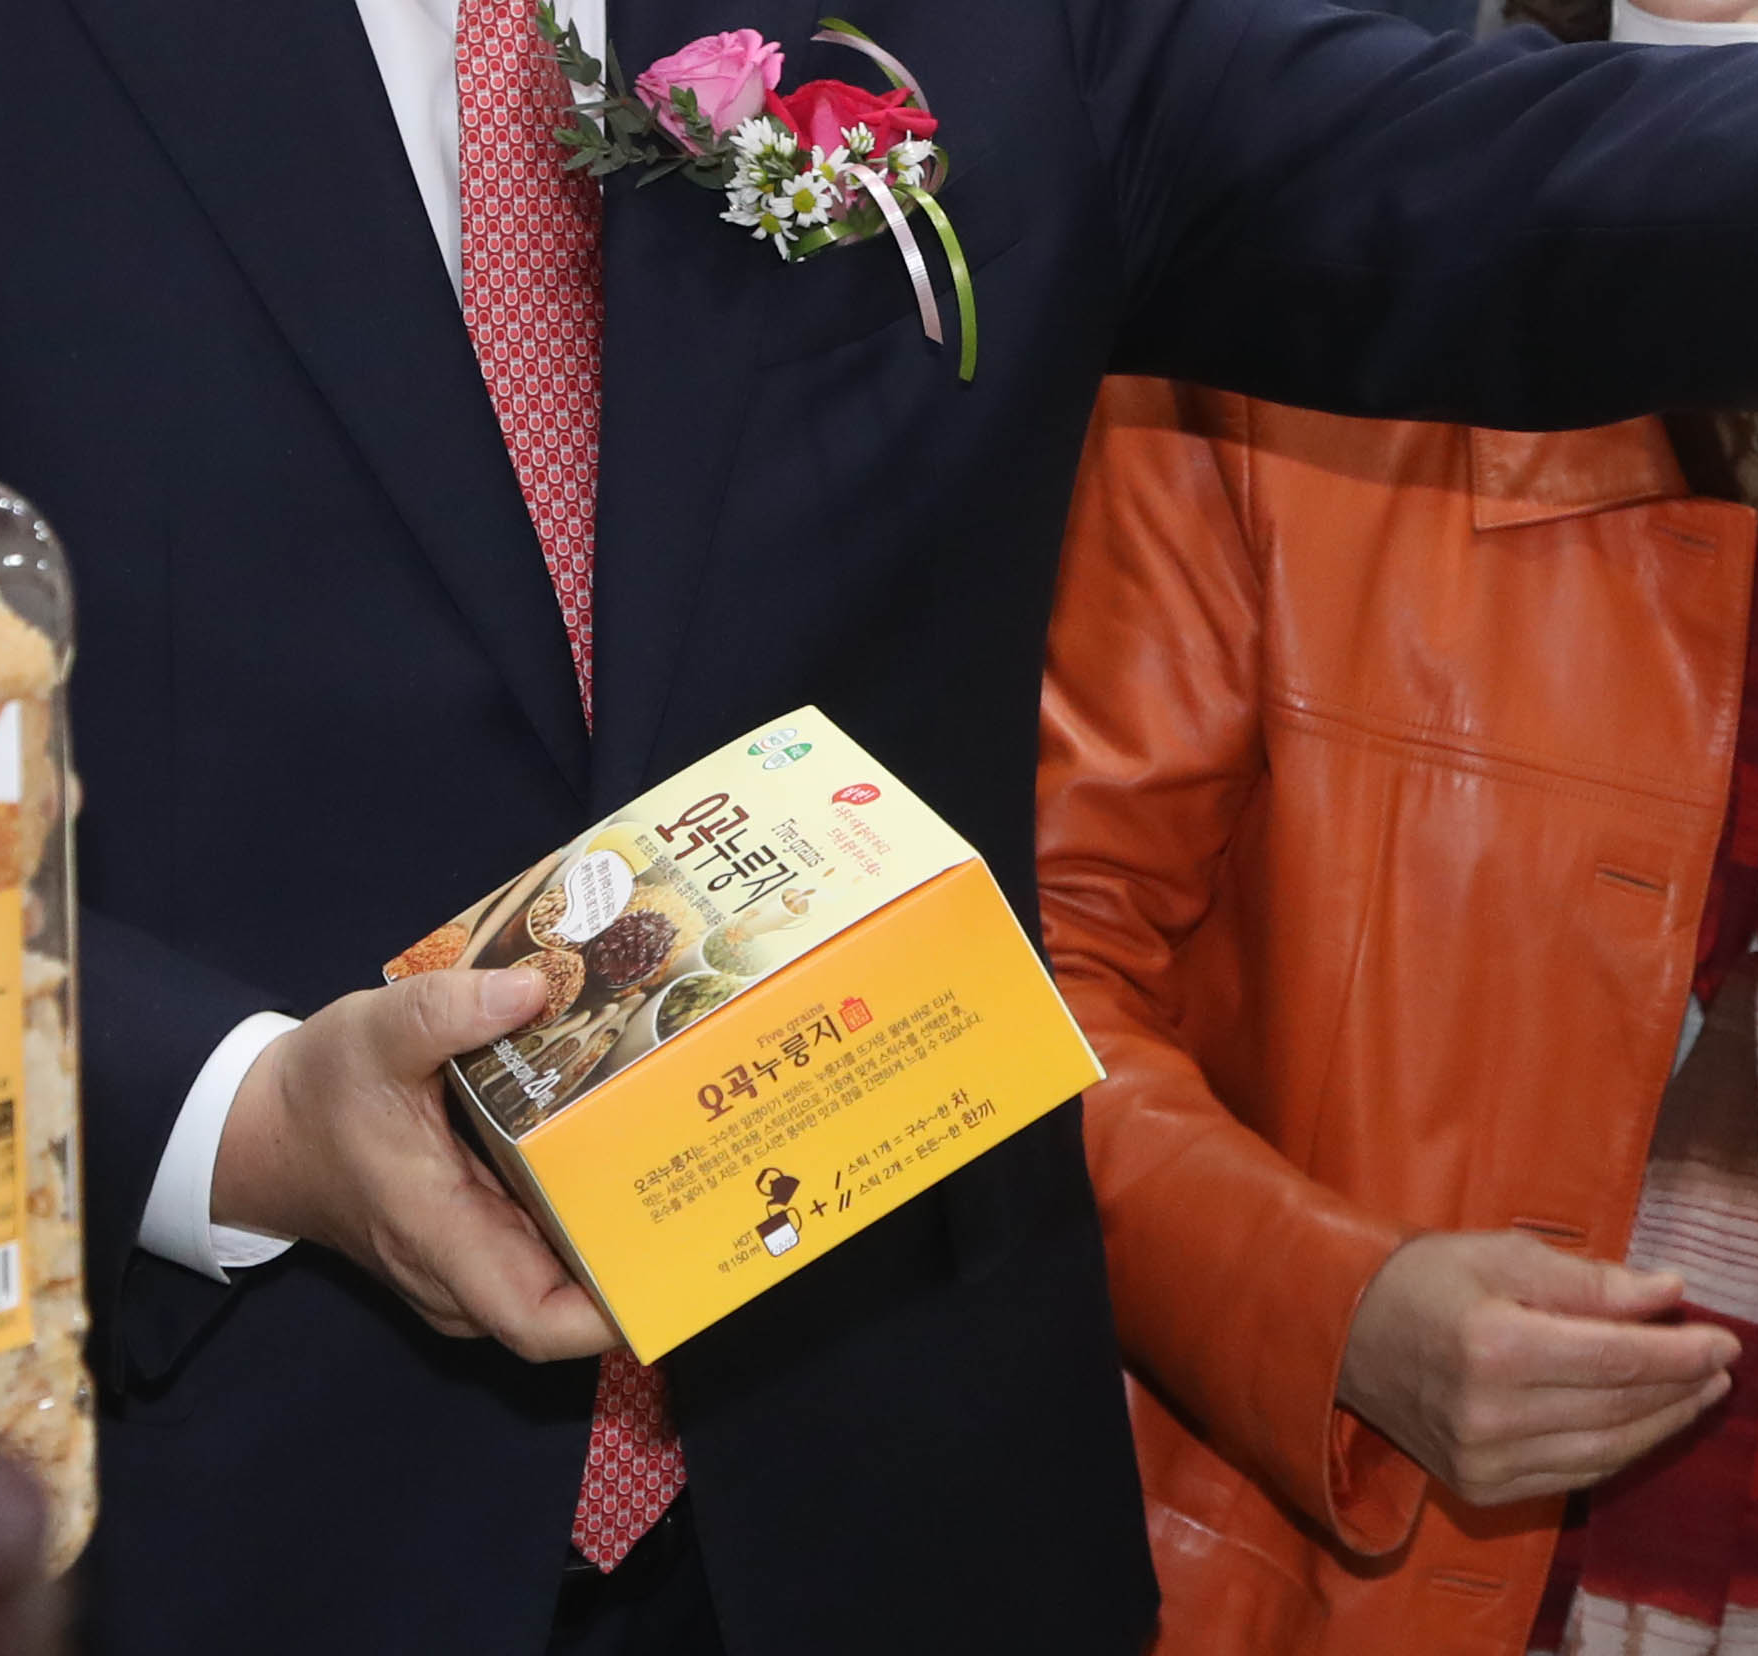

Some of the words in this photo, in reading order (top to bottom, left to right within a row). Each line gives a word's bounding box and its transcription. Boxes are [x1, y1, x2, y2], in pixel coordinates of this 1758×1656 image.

[770, 817, 799, 843] Five
[654, 792, 798, 914] 오곡누룽지
[781, 838, 825, 868] grains
[755, 1027, 784, 1049] Five
[785, 1002, 825, 1034] grains
[697, 1013, 842, 1122] 오곡누룽지
[950, 1087, 969, 1109] 차
[960, 1098, 996, 1129] 한끼
